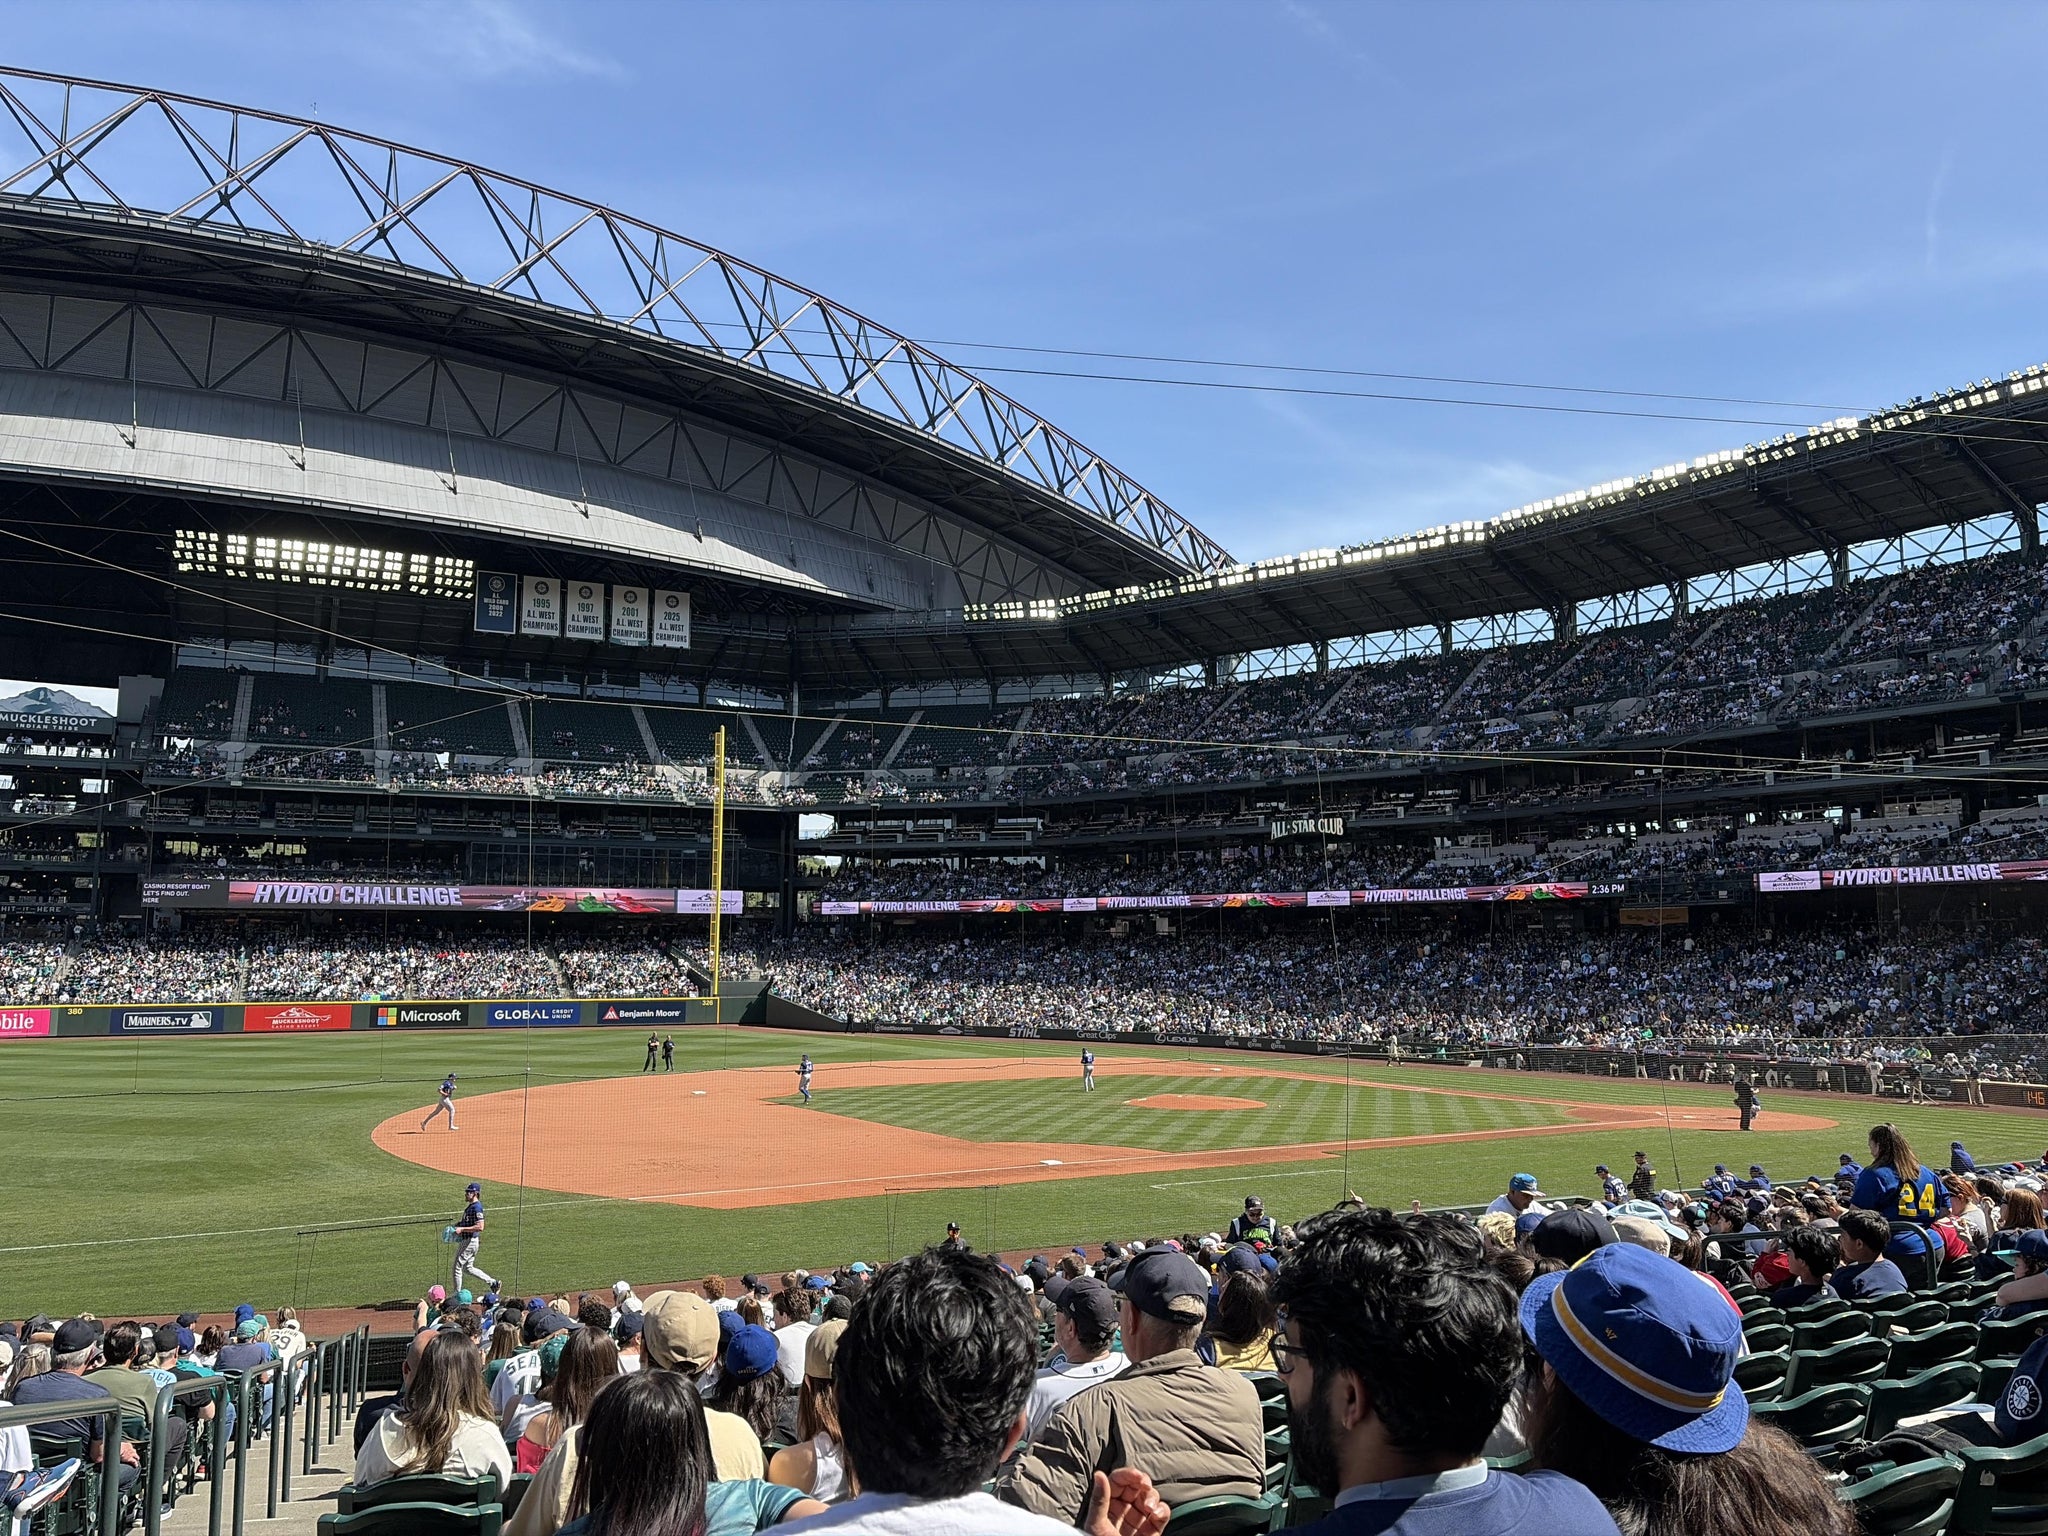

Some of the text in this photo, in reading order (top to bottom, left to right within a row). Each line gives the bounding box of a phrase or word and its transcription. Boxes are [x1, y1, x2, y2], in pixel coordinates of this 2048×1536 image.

[532, 598, 551, 608] 1995
[577, 602, 594, 613] 1997
[538, 610, 556, 620] WEST
[621, 606, 639, 618] 2001
[663, 611, 681, 622] 2025
[582, 615, 599, 624] WEST
[627, 619, 643, 628] WEST
[523, 620, 559, 632] CHAMPIONS
[567, 624, 603, 636] CHAMPIONS
[670, 624, 684, 632] WEST
[612, 628, 647, 640] CHAMPIONS
[655, 632, 688, 643] CHAMPIONS
[0, 713, 98, 727] MUCKLESHOOT
[1318, 818, 1344, 836] CLUB
[1832, 863, 2004, 886] HYDRO CHALLENGE
[1592, 884, 1624, 894] 2:36 PM
[252, 884, 463, 906] HYDRO CHALLENGE
[1364, 887, 1469, 903] HYDRO CHALLENGE
[870, 901, 961, 912] HYDRO CHALLENGE
[1106, 896, 1192, 908] HYDRO CHALLENGE
[400, 1009, 462, 1023] Microsoft
[494, 1009, 549, 1020] GLOBAL
[619, 1010, 655, 1018] Benjamin
[1008, 1027, 1041, 1038] STIHL
[1076, 1030, 1117, 1041] Great Clips
[1722, 1182, 1731, 1193] 0
[1898, 1182, 1936, 1218] 24
